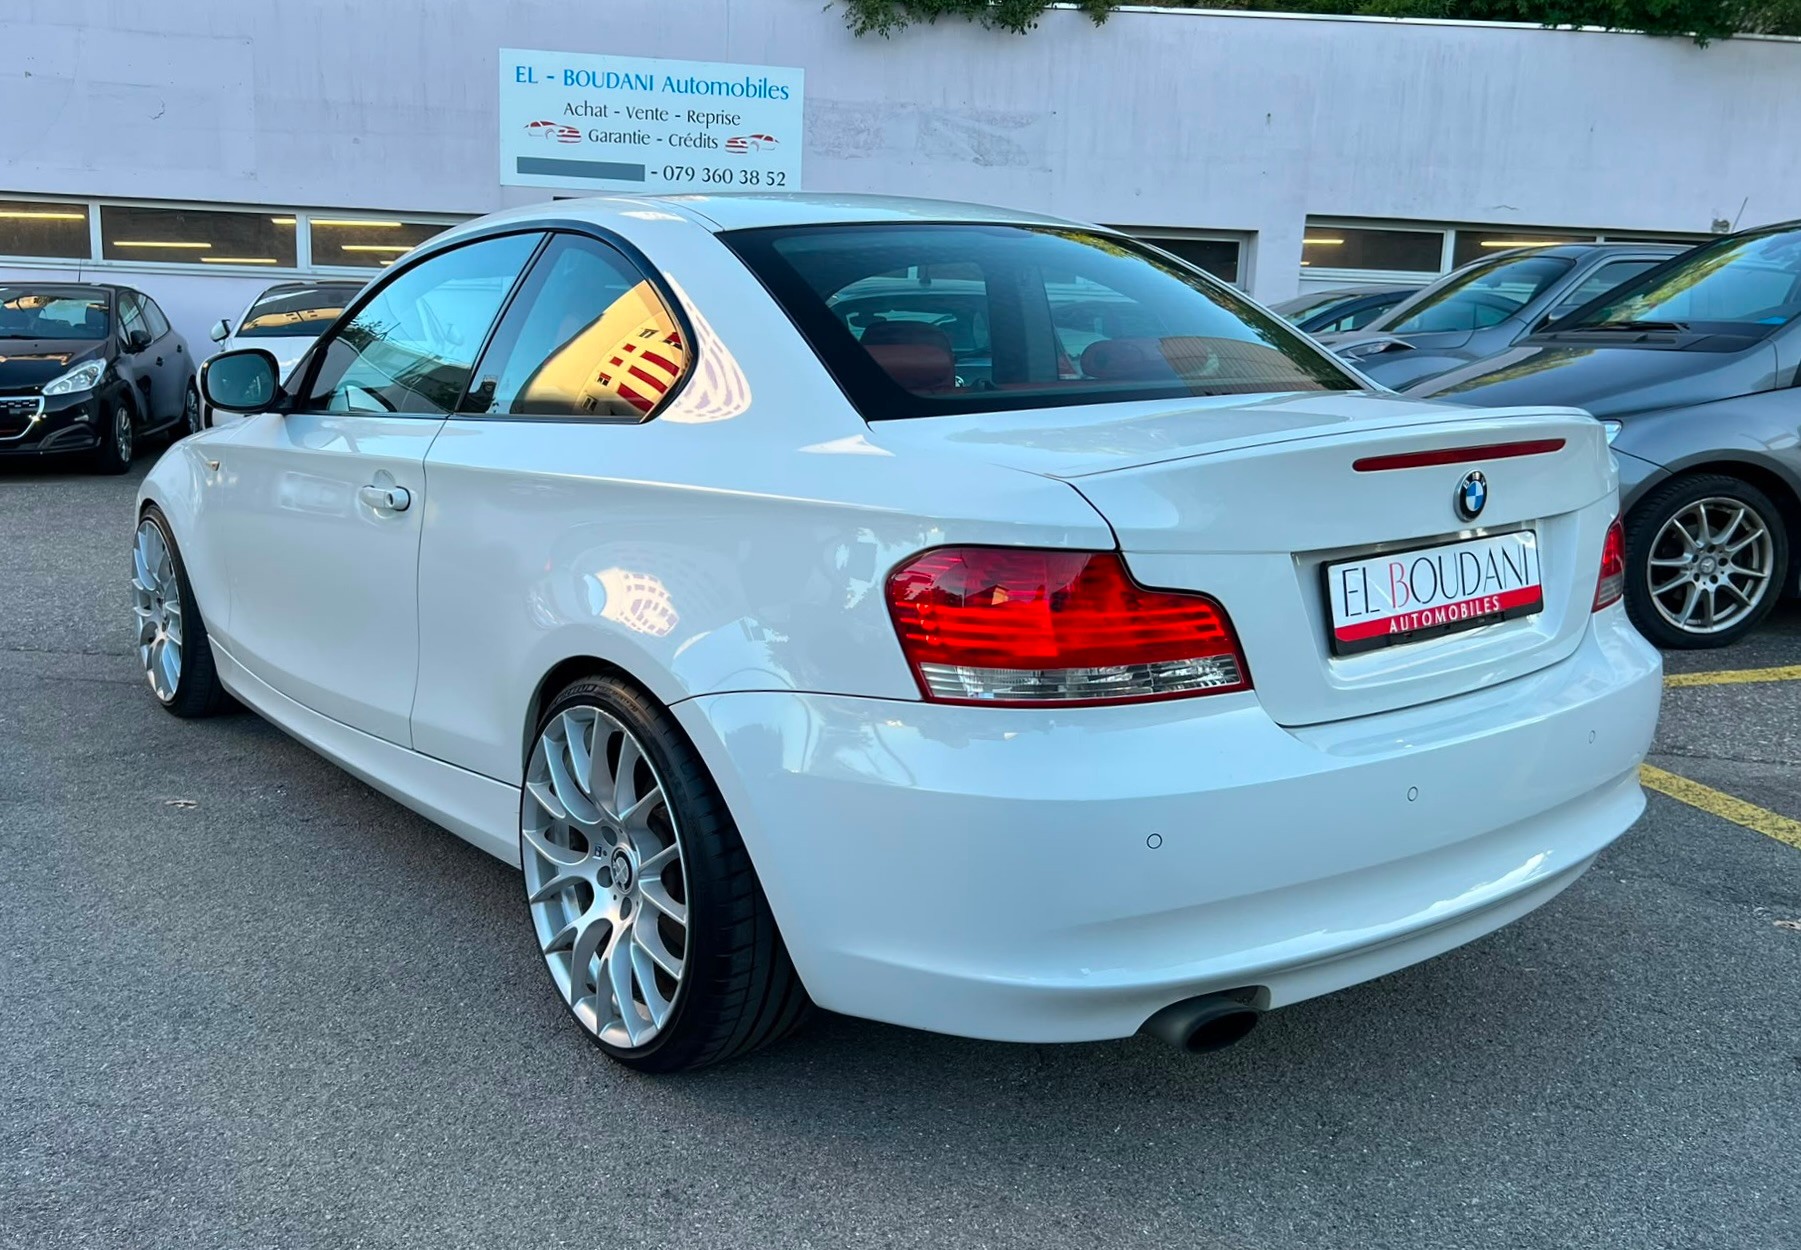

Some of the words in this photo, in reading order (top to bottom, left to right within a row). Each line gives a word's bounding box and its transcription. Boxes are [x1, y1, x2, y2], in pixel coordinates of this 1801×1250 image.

[516, 65, 539, 84] EL
[563, 68, 654, 91] BOUDANI
[661, 75, 789, 100] Automobiles
[563, 100, 608, 118] Achat
[626, 106, 669, 121] Vente
[687, 109, 741, 129] Reprise
[588, 129, 651, 146] Garantie
[668, 132, 718, 149] Crédits
[663, 165, 695, 182] 079
[702, 168, 733, 184] 360
[739, 170, 760, 186] 38
[766, 171, 786, 187] 52
[1342, 567, 1380, 618] EL
[1389, 543, 1530, 609] BOUDANI
[1389, 596, 1501, 634] AUTOMOBILES
